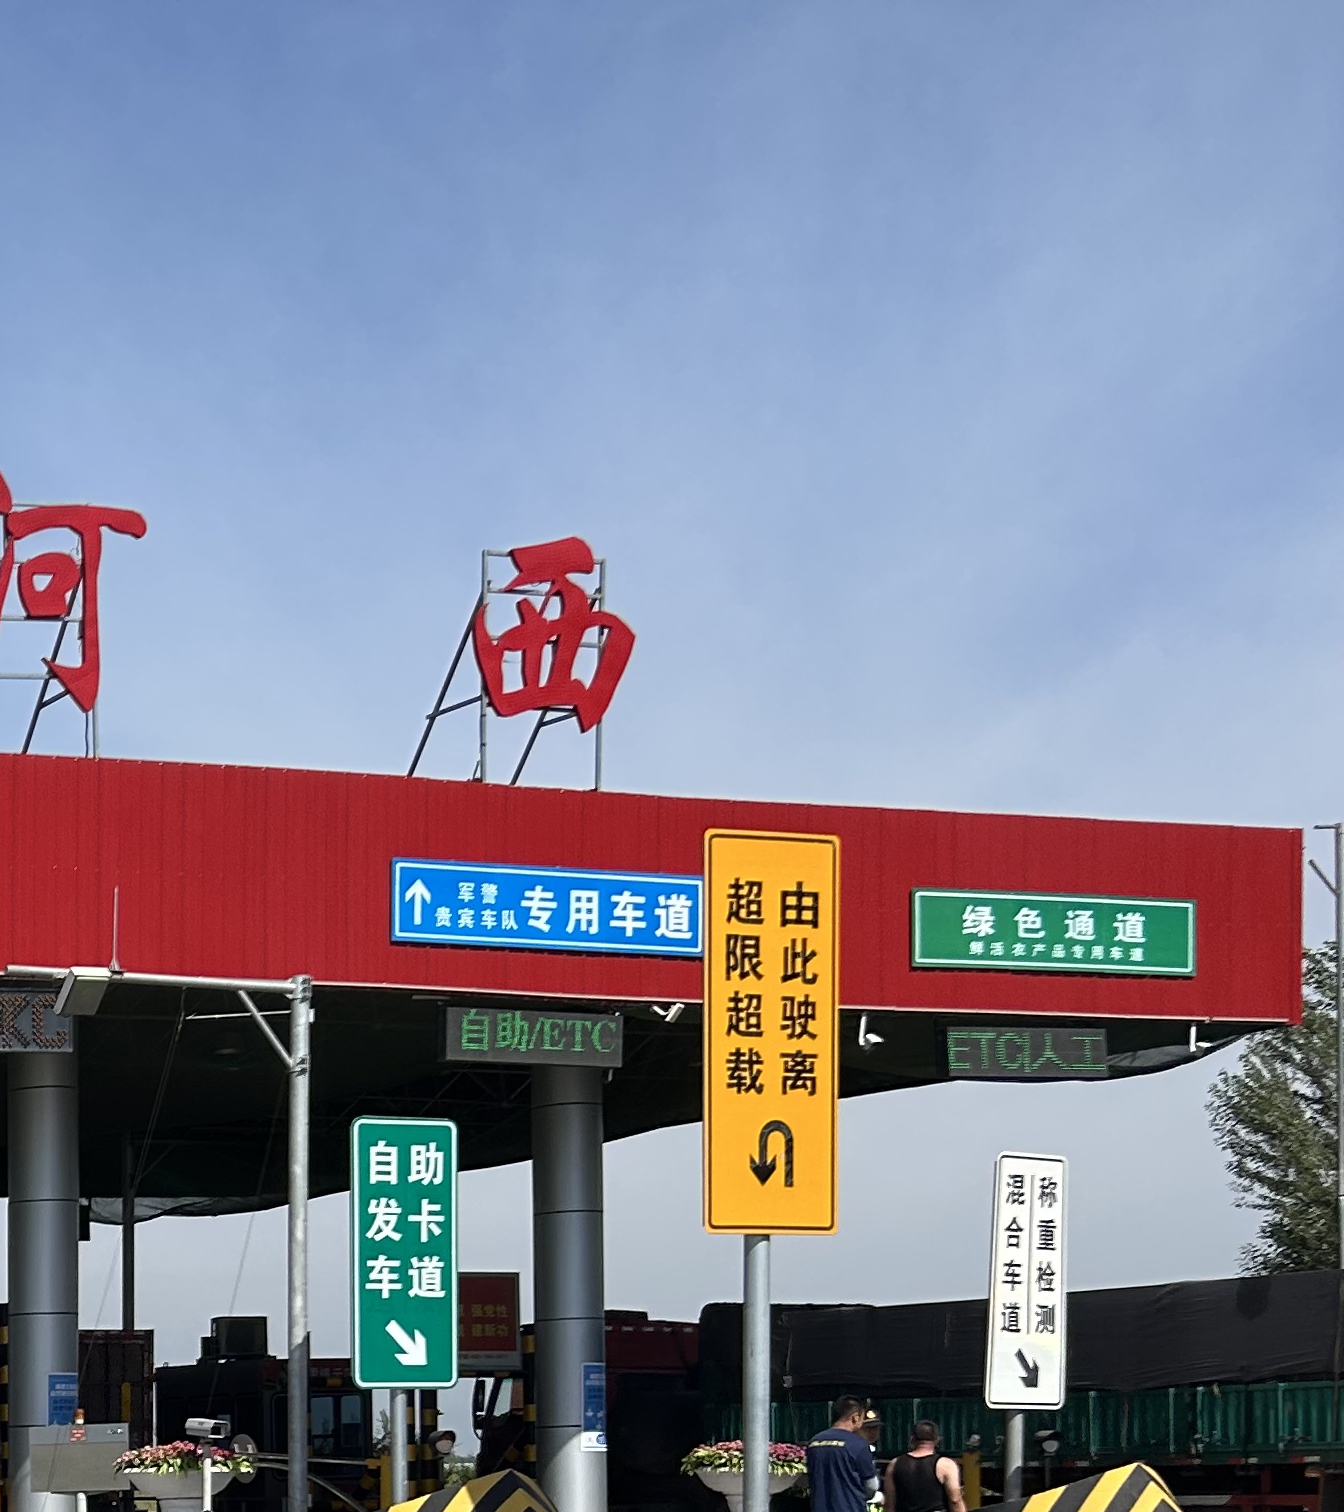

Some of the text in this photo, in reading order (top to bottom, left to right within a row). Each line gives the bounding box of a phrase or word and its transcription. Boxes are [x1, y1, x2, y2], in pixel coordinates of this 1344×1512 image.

[457, 881, 499, 904] 军警
[520, 885, 694, 940] 专用车道
[434, 906, 519, 931] 贵宾车队
[962, 904, 1146, 943] 绿色通道
[725, 876, 765, 1096] 超限超载
[779, 881, 820, 1097] 由此驶离
[460, 1008, 617, 1054] 自助/ETC
[368, 1140, 445, 1186] 自助
[365, 1197, 445, 1242] 发卡
[365, 1255, 446, 1299] 车道
[1000, 1174, 1026, 1334] 混合车道
[1035, 1176, 1059, 1335] 称重检测
